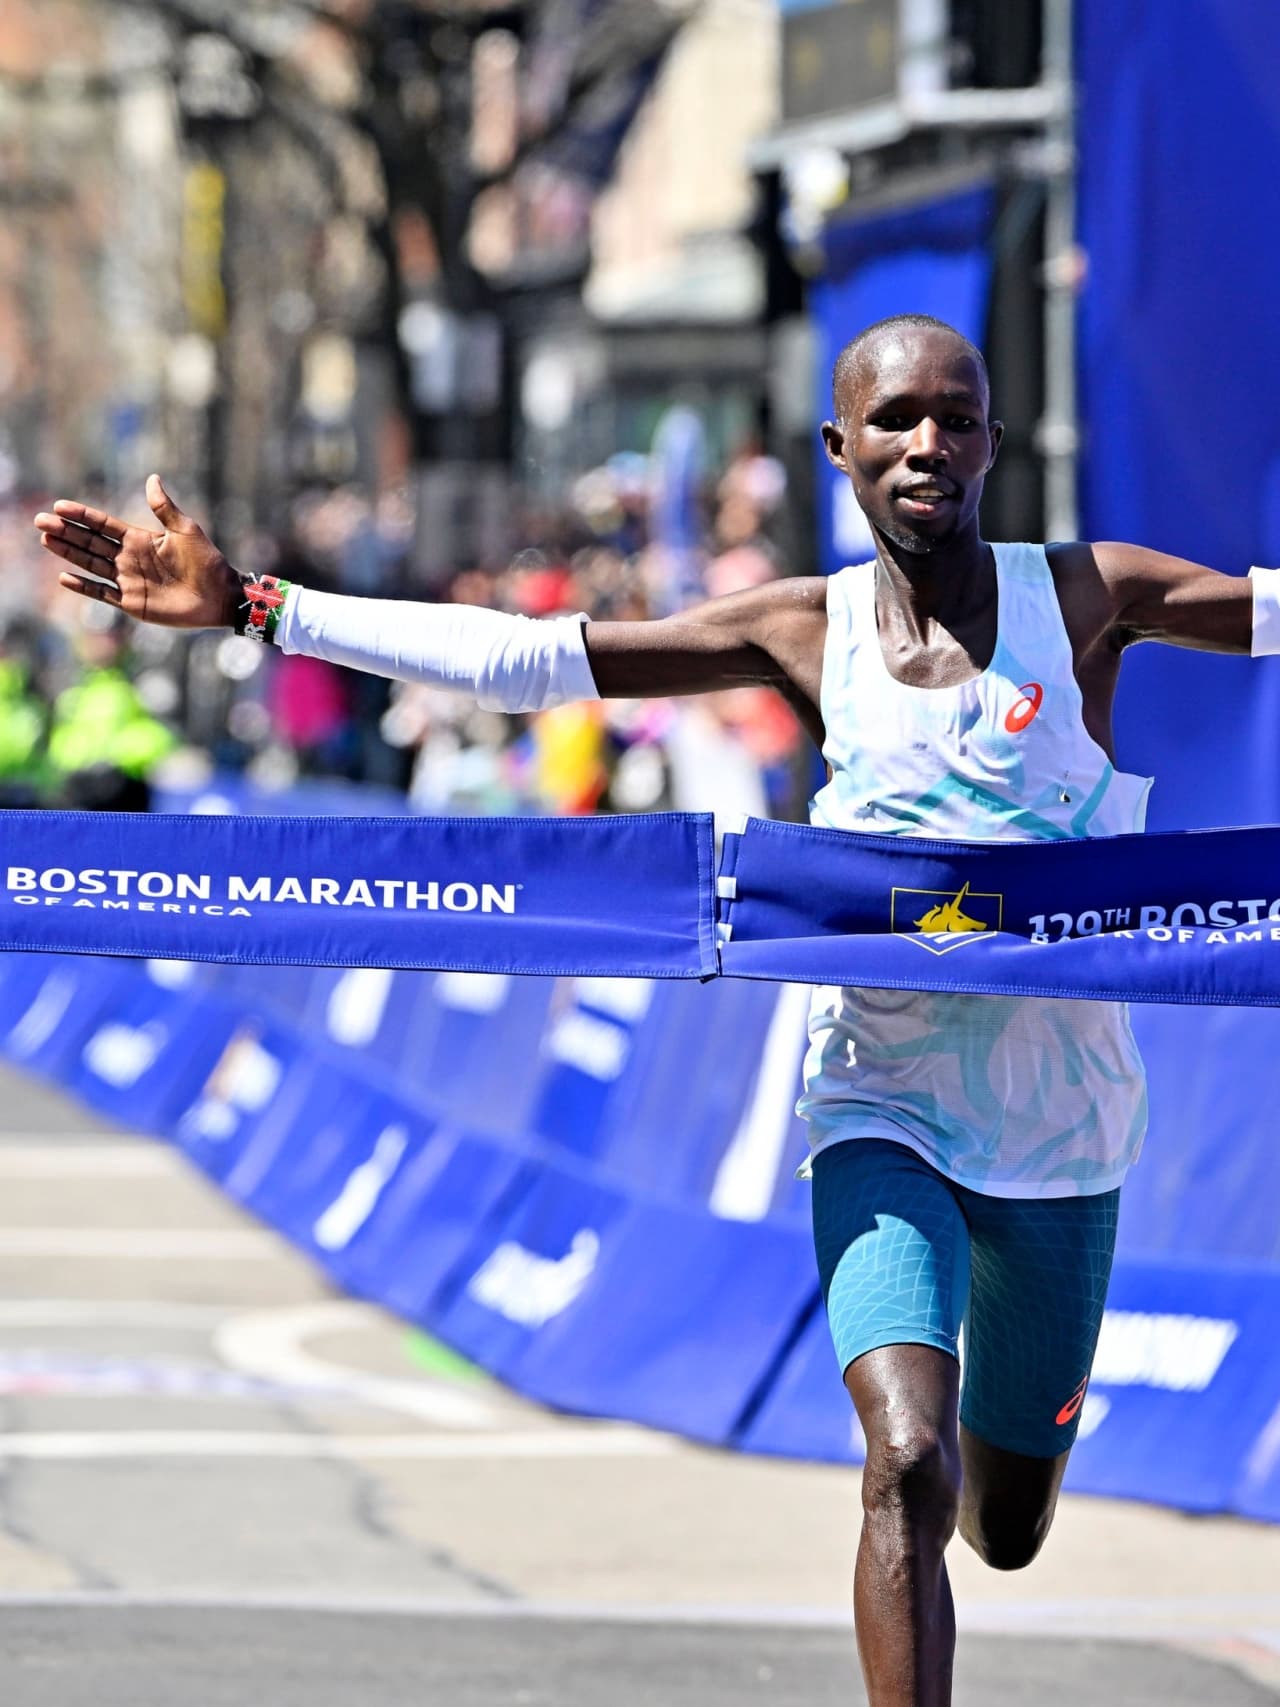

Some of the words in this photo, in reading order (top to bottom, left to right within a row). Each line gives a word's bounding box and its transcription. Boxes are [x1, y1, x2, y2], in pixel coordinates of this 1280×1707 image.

[6, 867, 211, 899] BOSTON
[228, 876, 516, 914] MARATHON
[13, 895, 62, 906] OF
[72, 899, 252, 917] AMERICA
[1147, 927, 1195, 944] OF
